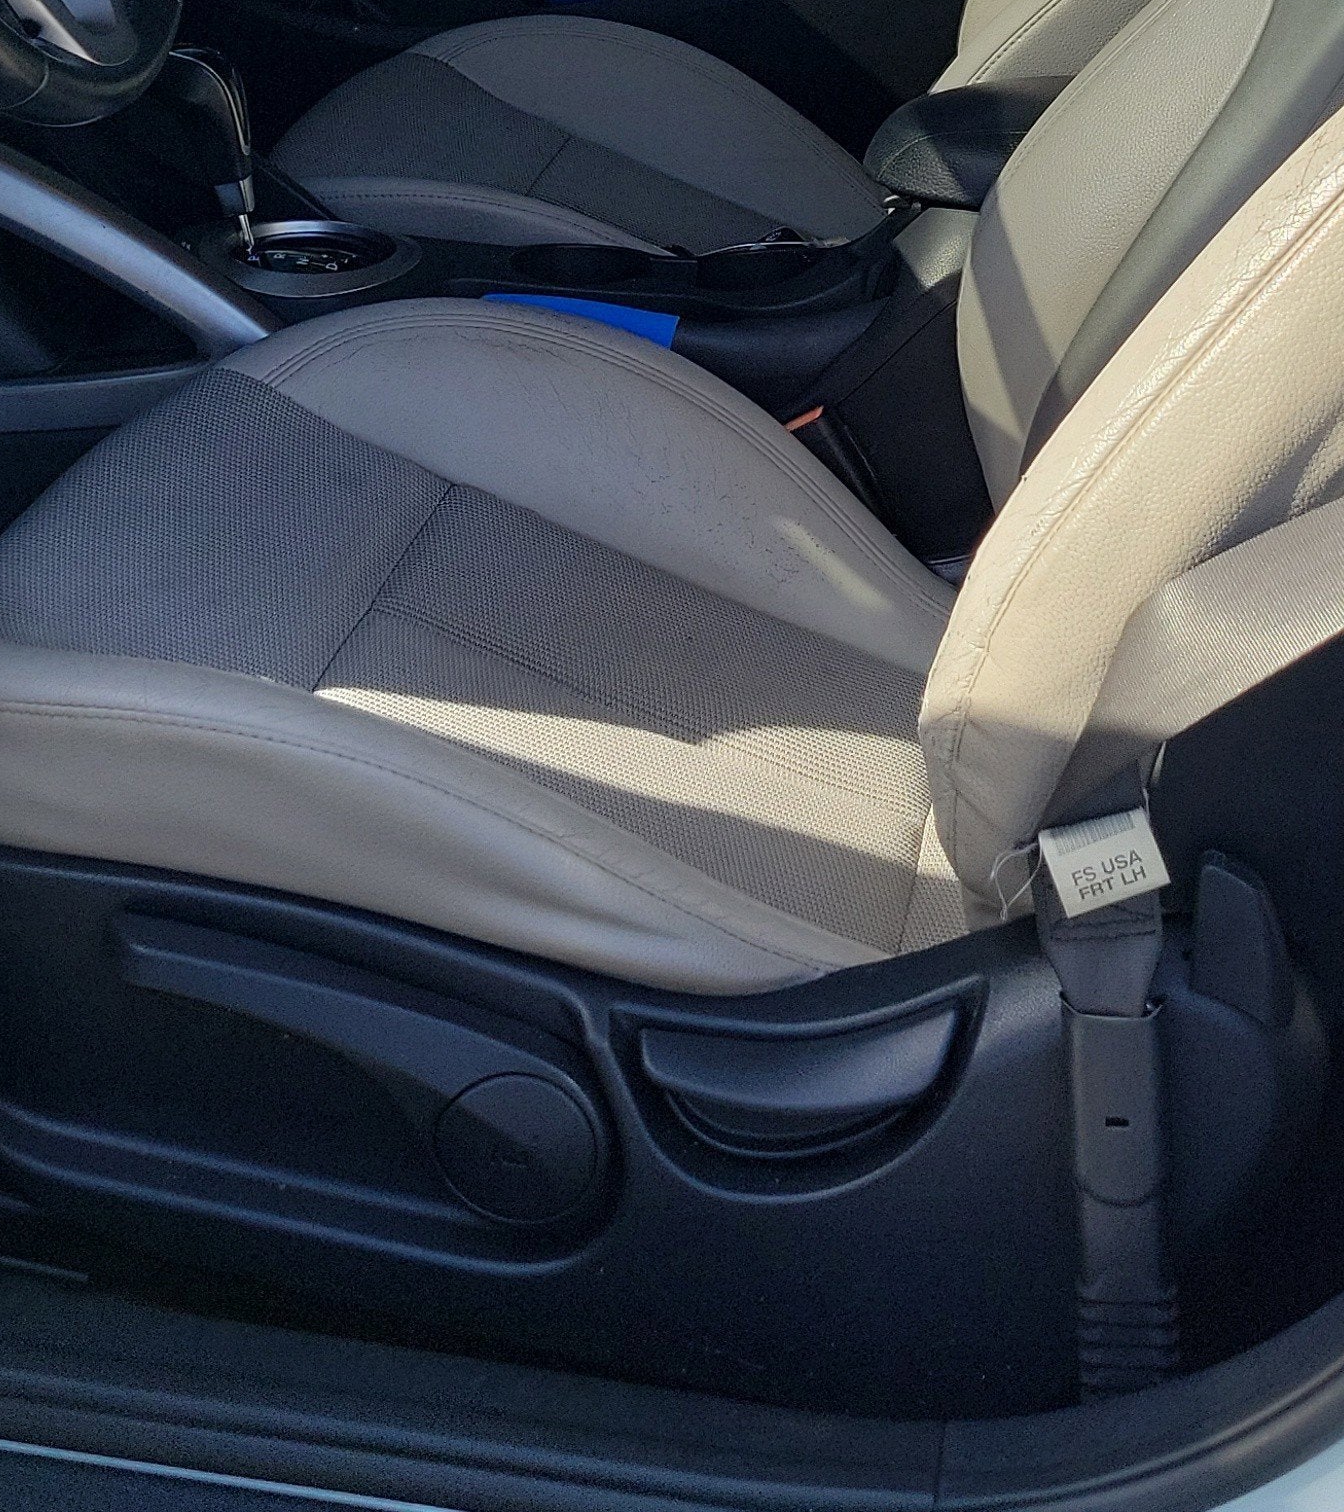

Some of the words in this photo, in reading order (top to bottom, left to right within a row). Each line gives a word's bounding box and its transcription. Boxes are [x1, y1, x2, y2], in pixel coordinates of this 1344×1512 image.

[1071, 866, 1097, 886] FS
[1101, 849, 1143, 874] USA
[1079, 876, 1115, 899] FRT
[1121, 865, 1147, 886] LH
